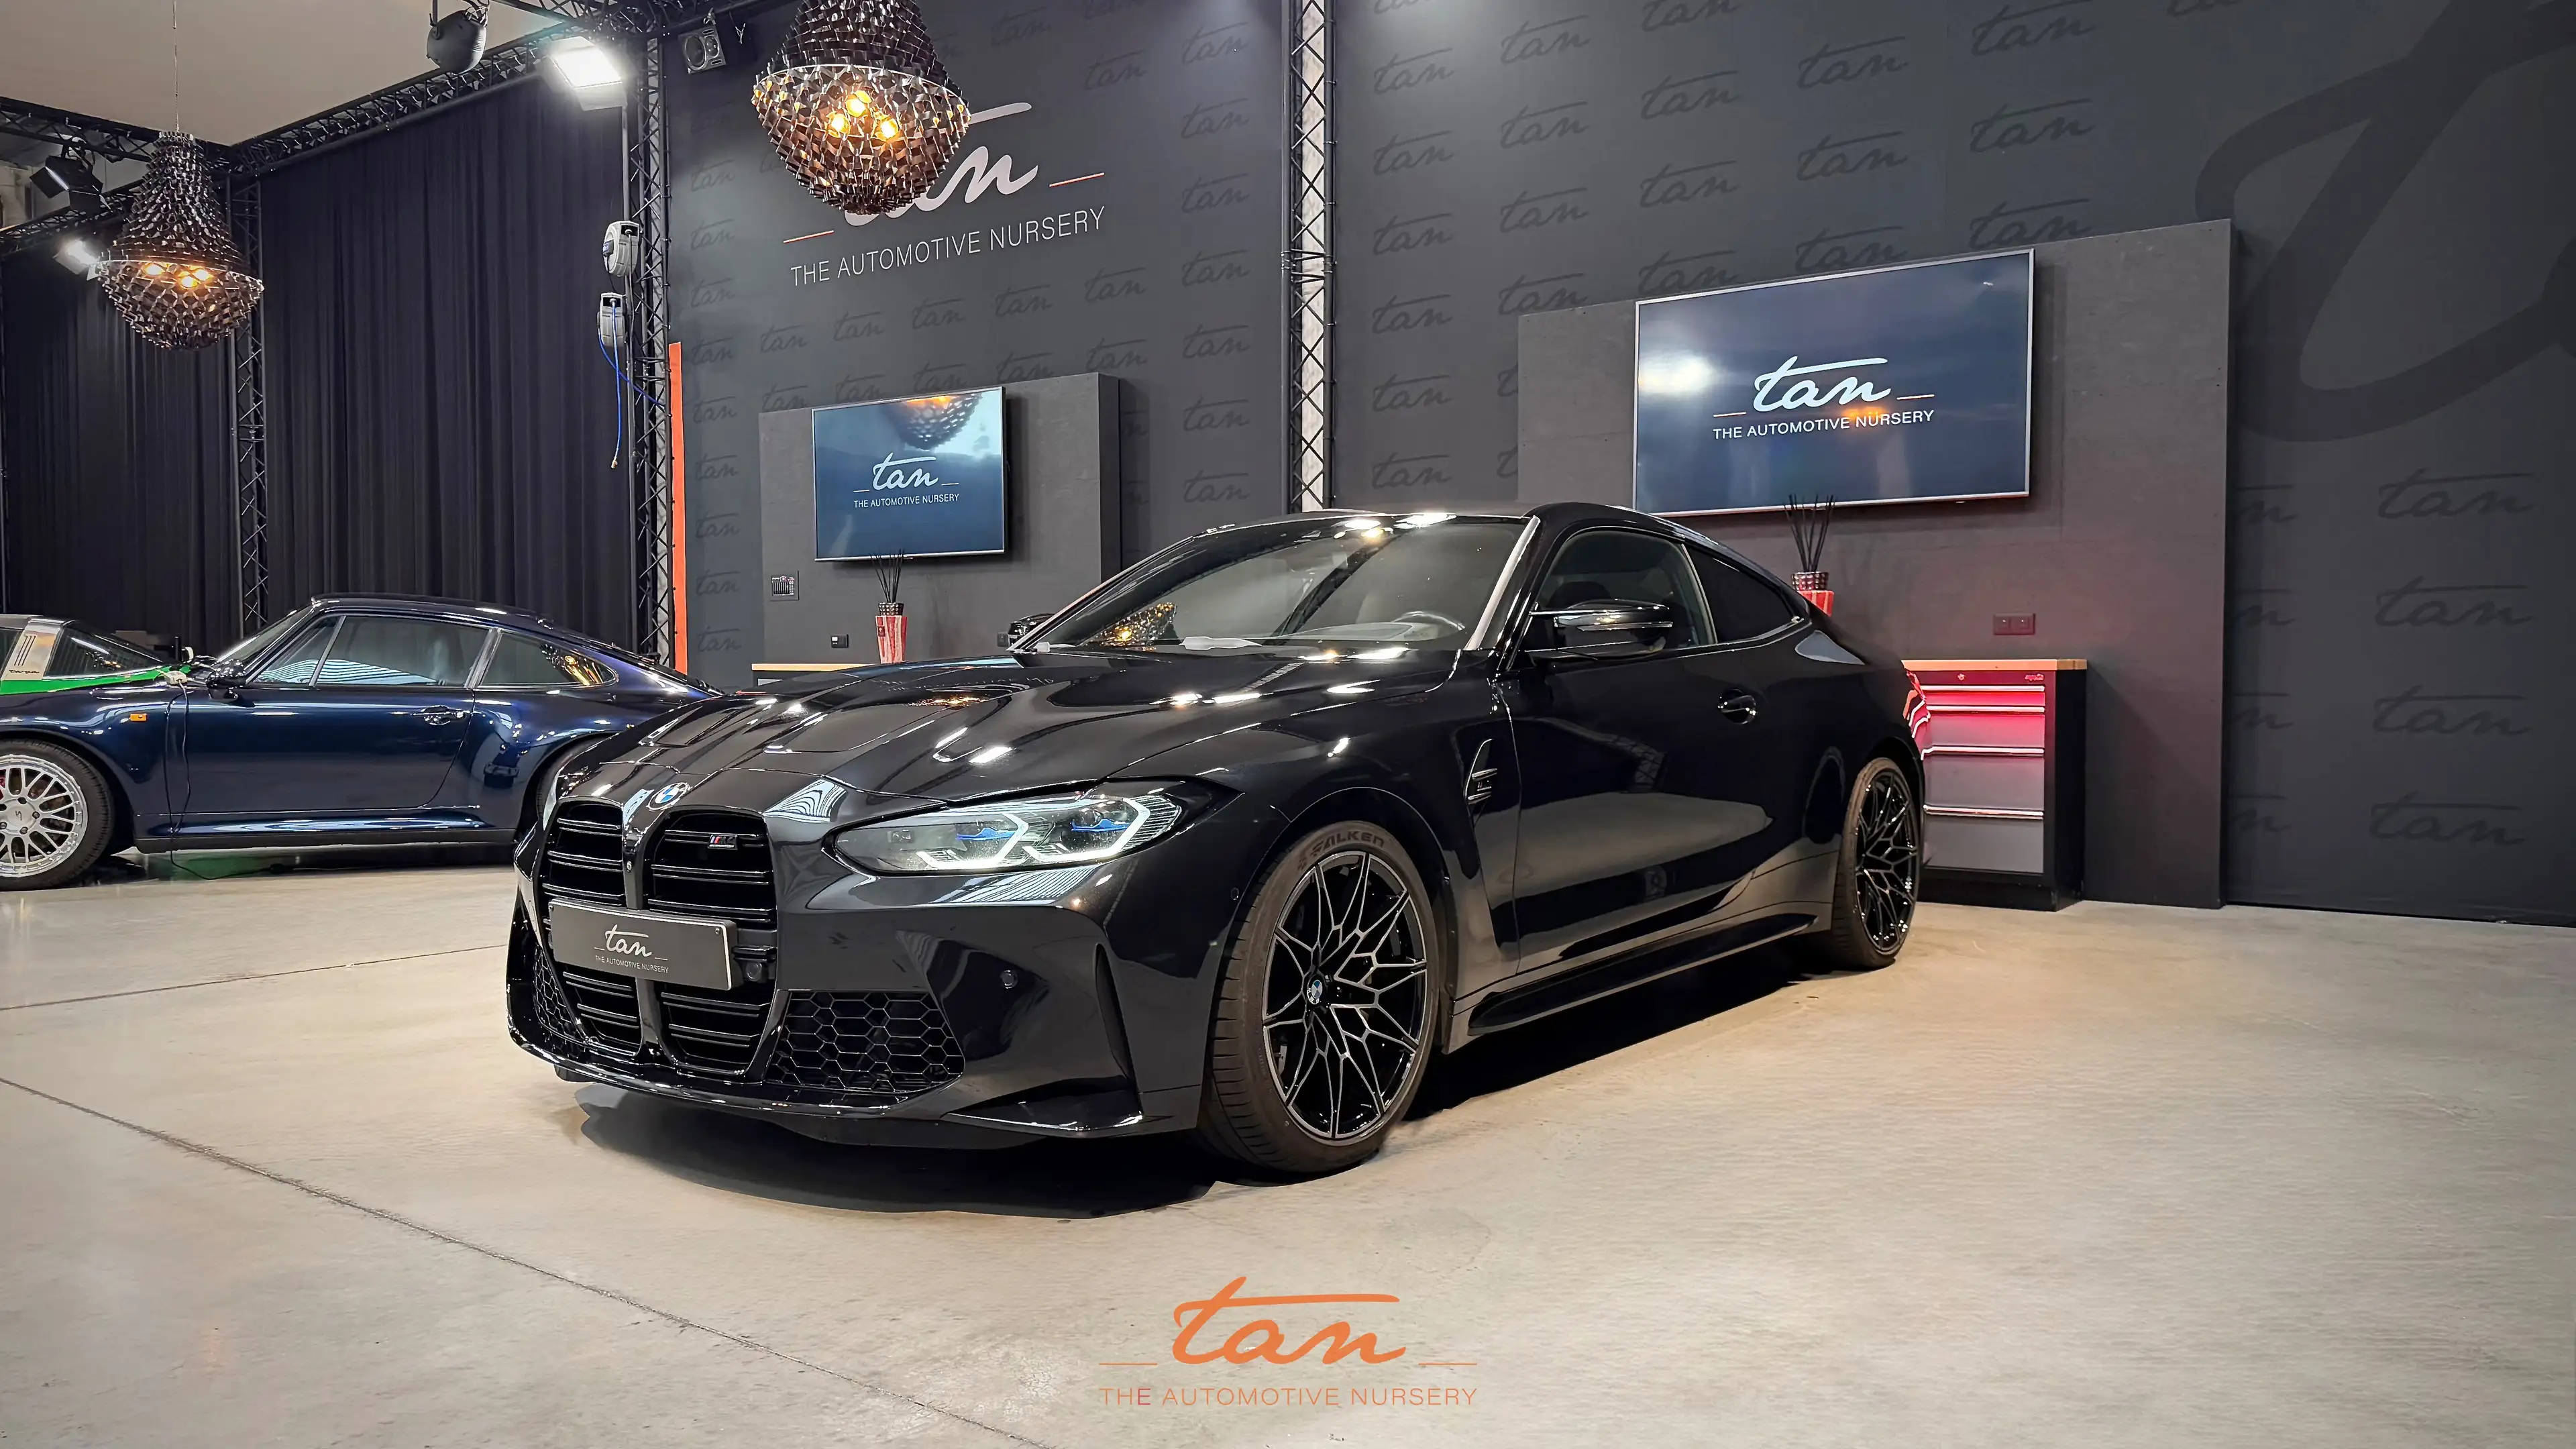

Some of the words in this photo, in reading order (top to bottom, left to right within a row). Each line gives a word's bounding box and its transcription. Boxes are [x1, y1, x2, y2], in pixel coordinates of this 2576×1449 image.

[1642, 0, 1742, 32] tan
[1971, 0, 2099, 56] tan
[1181, 22, 1249, 64] tan
[1501, 15, 1592, 64] tan
[1082, 50, 1146, 90] tan
[1375, 48, 1454, 95] tan
[1796, 36, 1910, 90] tan
[1641, 70, 1741, 120] tan
[1181, 98, 1249, 139] tan
[1500, 101, 1591, 149] tan
[1969, 98, 2097, 154] tan
[1373, 130, 1454, 175] tan
[1796, 131, 1909, 182] tan
[691, 159, 736, 192] tan
[1181, 172, 1250, 214] tan
[1640, 160, 1740, 208] tan
[1500, 187, 1590, 233] tan
[1969, 199, 2093, 251] tan
[691, 219, 735, 250] tan
[790, 260, 830, 286] THE
[837, 231, 981, 278] AUTOMOTIVE
[989, 205, 1105, 251] NURSERY
[1373, 213, 1454, 256] tan
[1795, 225, 1908, 272] tan
[1084, 266, 1147, 304] tan
[1181, 250, 1250, 287] tan
[1638, 250, 1739, 294] tan
[691, 278, 735, 308] tan
[995, 284, 1053, 317] tan
[1498, 272, 1589, 316] tan
[833, 310, 886, 342] tan
[912, 297, 967, 330] tan
[1373, 294, 1454, 334] tan
[691, 337, 736, 366] tan
[761, 324, 809, 354] tan
[1182, 323, 1250, 358] tan
[1373, 373, 1452, 412] tan
[1753, 356, 1891, 412] tan
[693, 396, 737, 424] tan
[1183, 396, 1250, 431] tan
[1713, 427, 1742, 440] THE
[1746, 417, 1850, 437] AUTOMOTIVE
[1856, 409, 1935, 428] NURSERY
[695, 453, 738, 481] tan
[873, 452, 938, 490] tan
[1183, 470, 1251, 503] tan
[1372, 452, 1453, 489] tan
[853, 499, 869, 508] THE
[870, 495, 920, 507] AUTOMOTIVE
[922, 493, 959, 504] NURSERY
[2378, 468, 2538, 519] tan
[696, 511, 740, 537] tan
[696, 570, 741, 596] tan
[2375, 576, 2536, 627] tan
[697, 626, 742, 652] tan
[2373, 684, 2532, 736] tan
[2369, 790, 2525, 846] tan
[604, 924, 652, 957] tan
[595, 955, 606, 963] THE
[606, 957, 641, 969] AUTOMOTIVE
[641, 963, 669, 973] NURSERY
